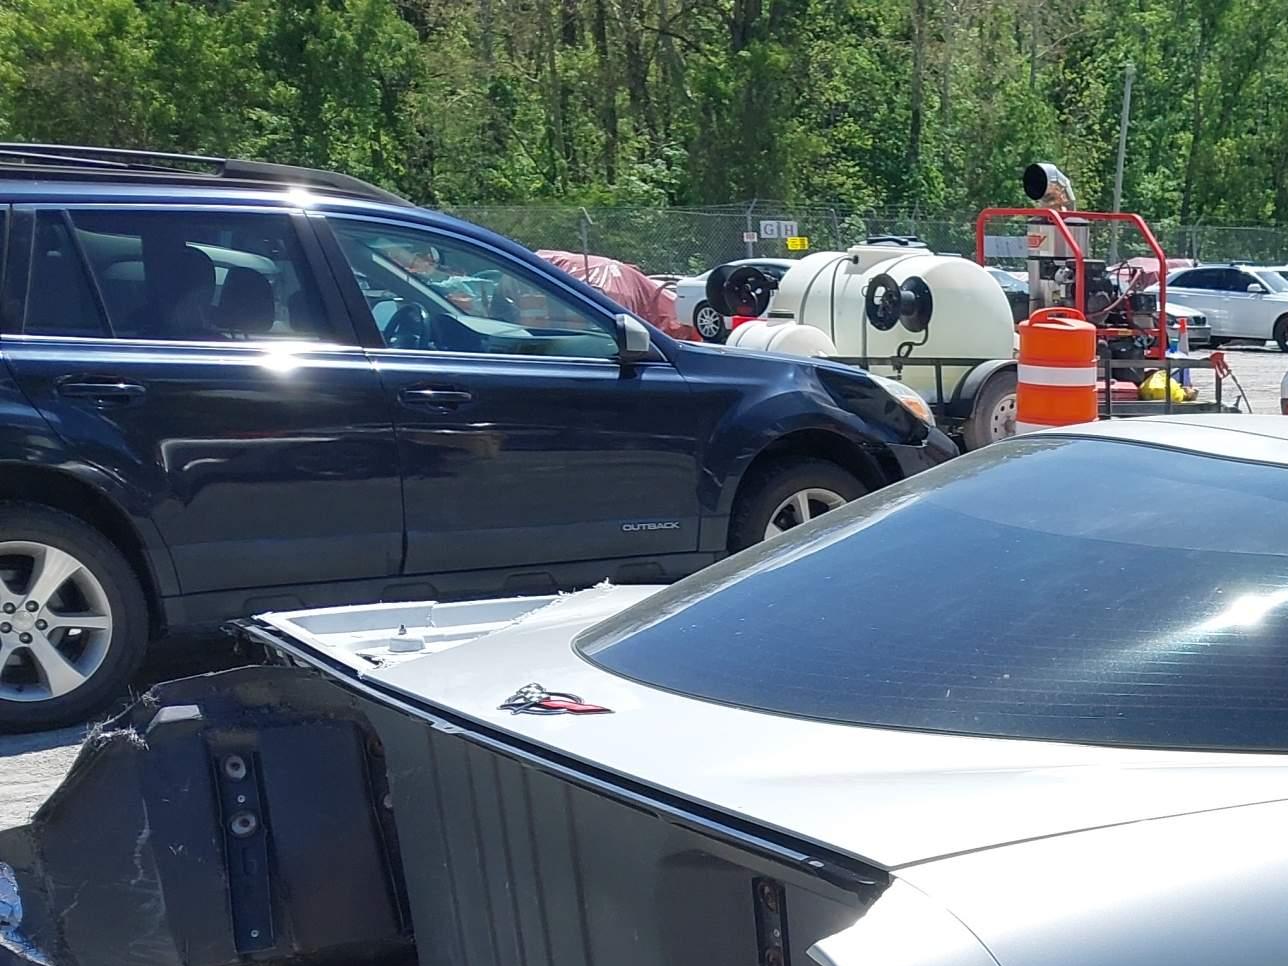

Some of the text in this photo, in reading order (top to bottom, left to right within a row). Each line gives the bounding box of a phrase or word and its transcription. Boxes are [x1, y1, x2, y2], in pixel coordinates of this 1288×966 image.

[763, 223, 775, 236] G
[783, 224, 795, 236] H
[622, 522, 680, 531] OUTBACK
